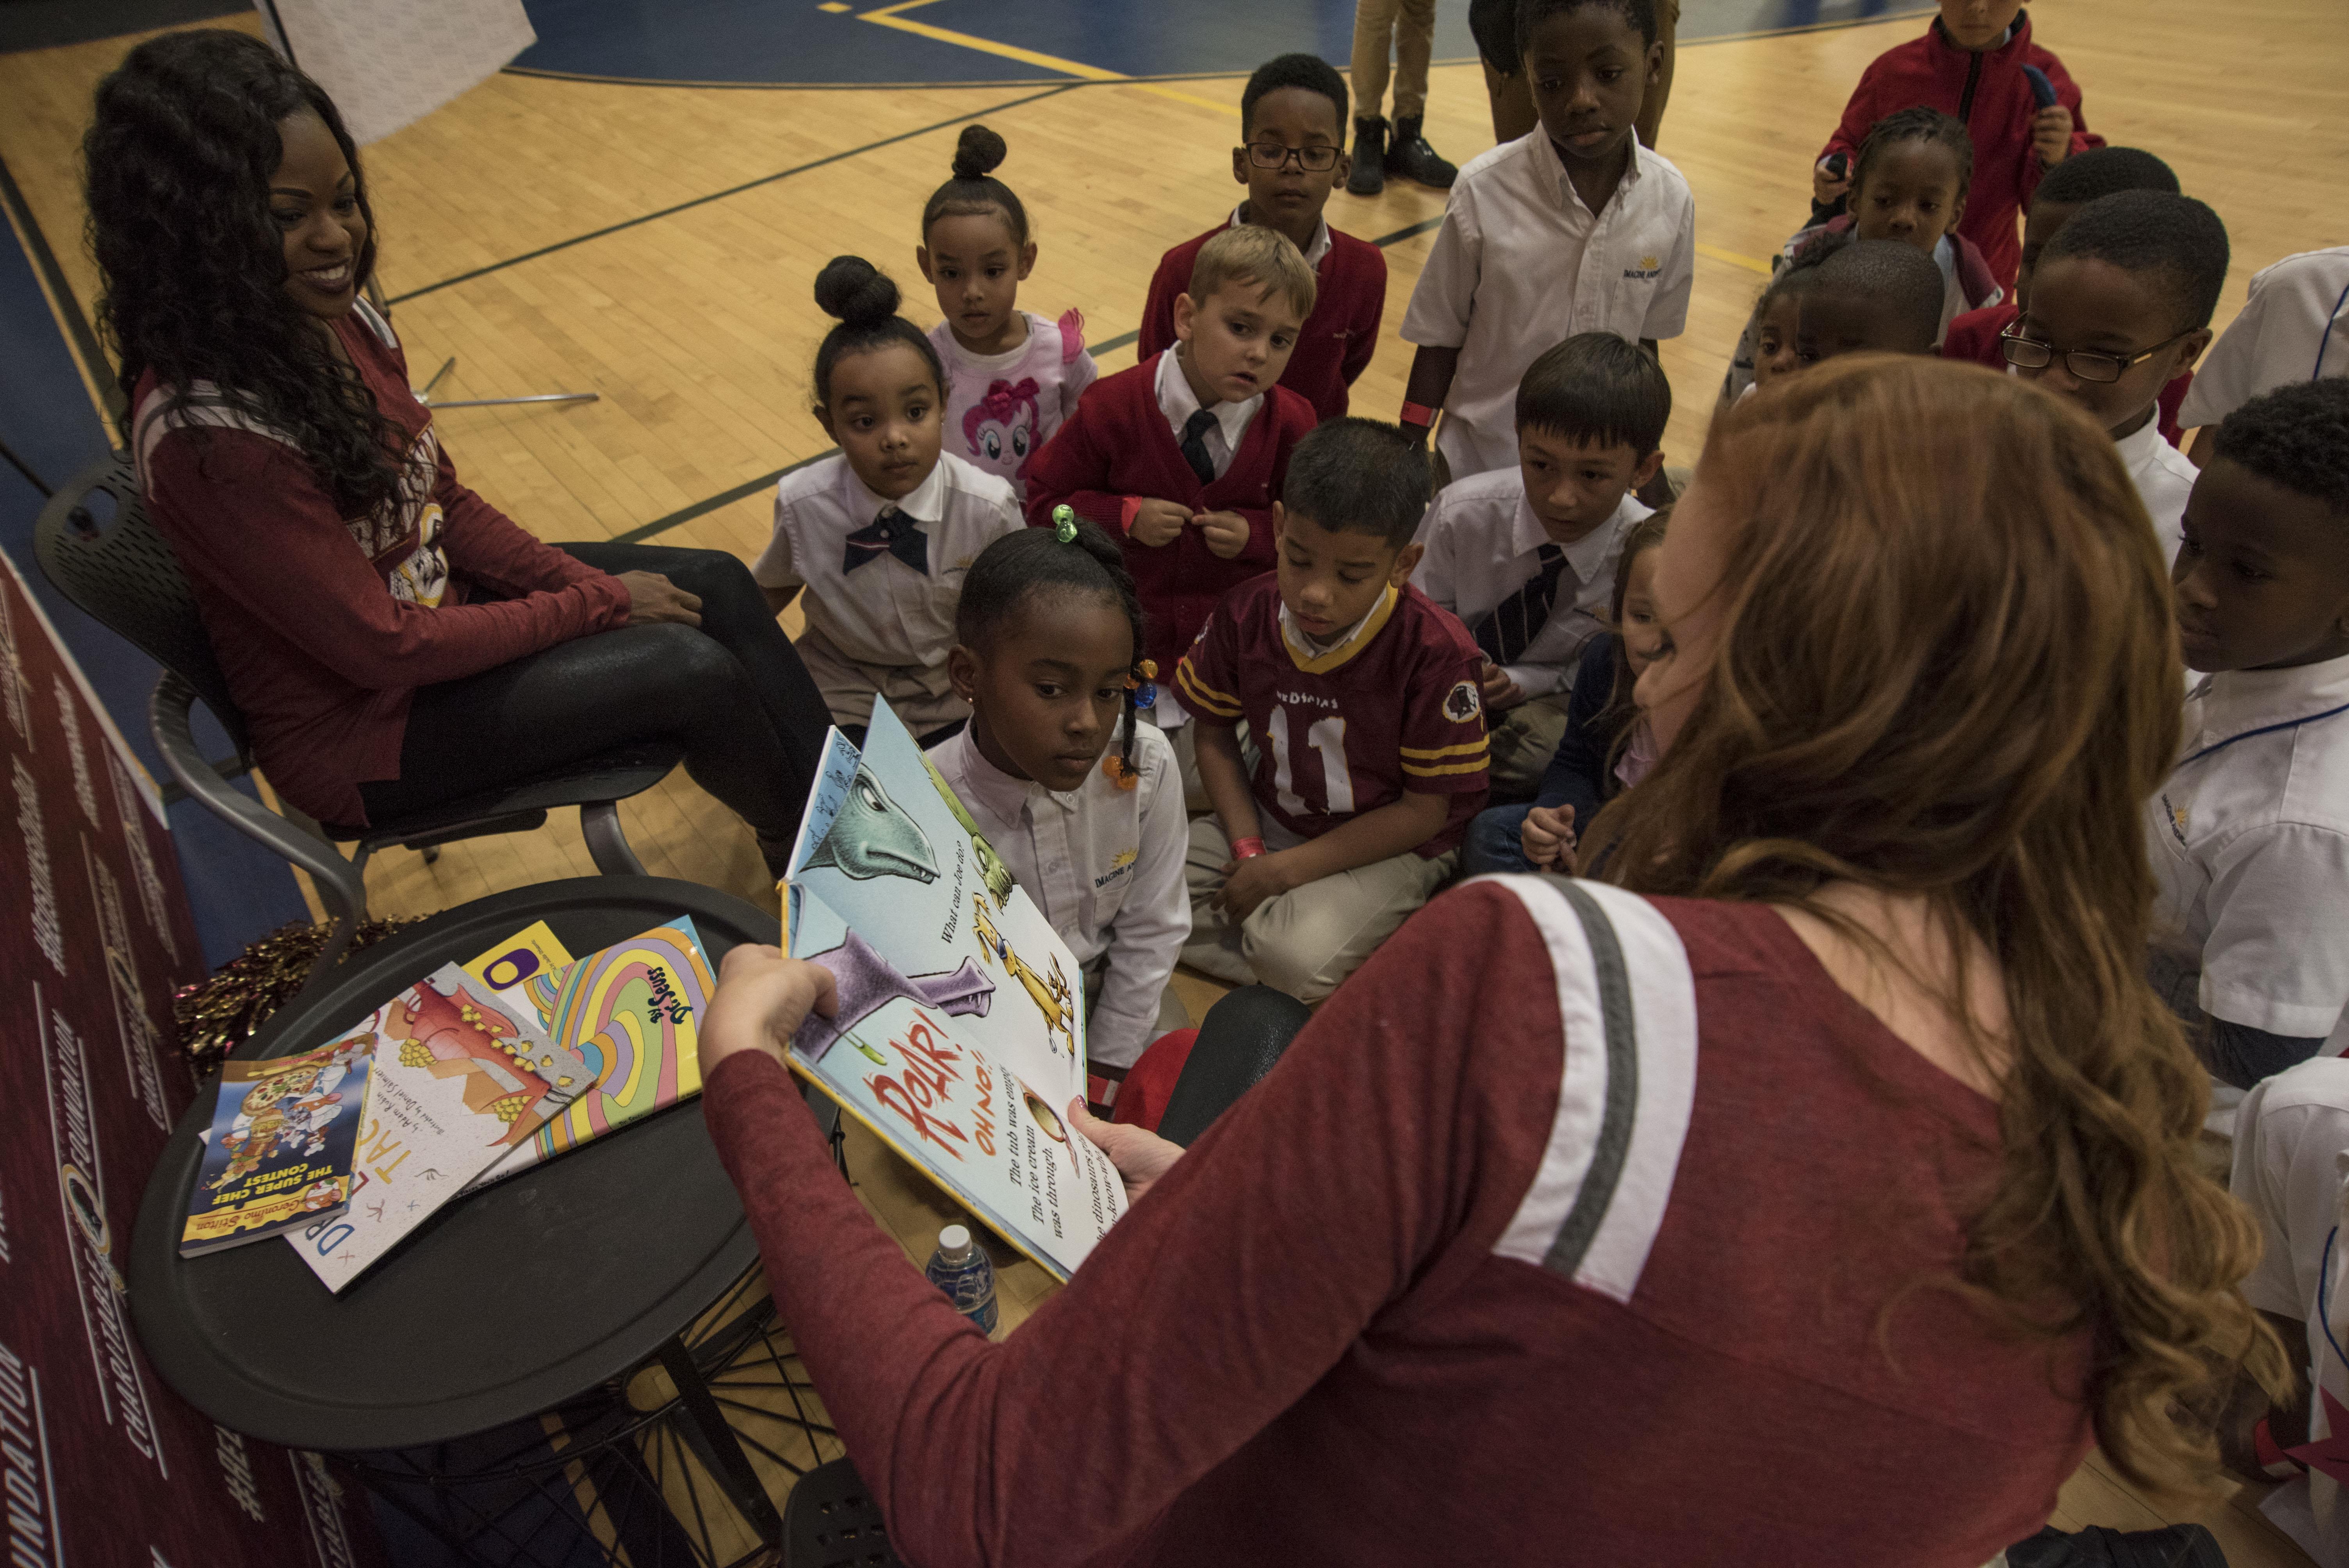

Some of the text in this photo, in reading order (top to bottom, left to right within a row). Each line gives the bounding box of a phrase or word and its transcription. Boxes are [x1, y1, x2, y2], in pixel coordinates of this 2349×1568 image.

[1266, 703, 1355, 817] 11
[941, 840, 965, 944] What can Joe do?
[1094, 866, 1125, 888] IMAGINE
[647, 966, 693, 1025] Dr. Seuss
[647, 1007, 664, 1025] By
[52, 1007, 93, 1181] FOUNDATION
[377, 1092, 396, 1112] Rubin
[393, 1089, 417, 1110] Daniel
[862, 1006, 970, 1162] ROAR!
[393, 1108, 412, 1128] Adam
[971, 1108, 996, 1156] OH
[1008, 1102, 1017, 1128] was
[1006, 1132, 1019, 1156] tub
[212, 1165, 333, 1206] THE SUPER CHEF
[243, 1163, 308, 1188] CONTEST
[1010, 1157, 1022, 1187] The
[1026, 1125, 1045, 1225] The ice cream
[1042, 1146, 1064, 1239] was through.
[1085, 1155, 1104, 1223] dinosaurs
[196, 1198, 300, 1230] Geronimo Stilton
[83, 1247, 155, 1459] CHARITABLE
